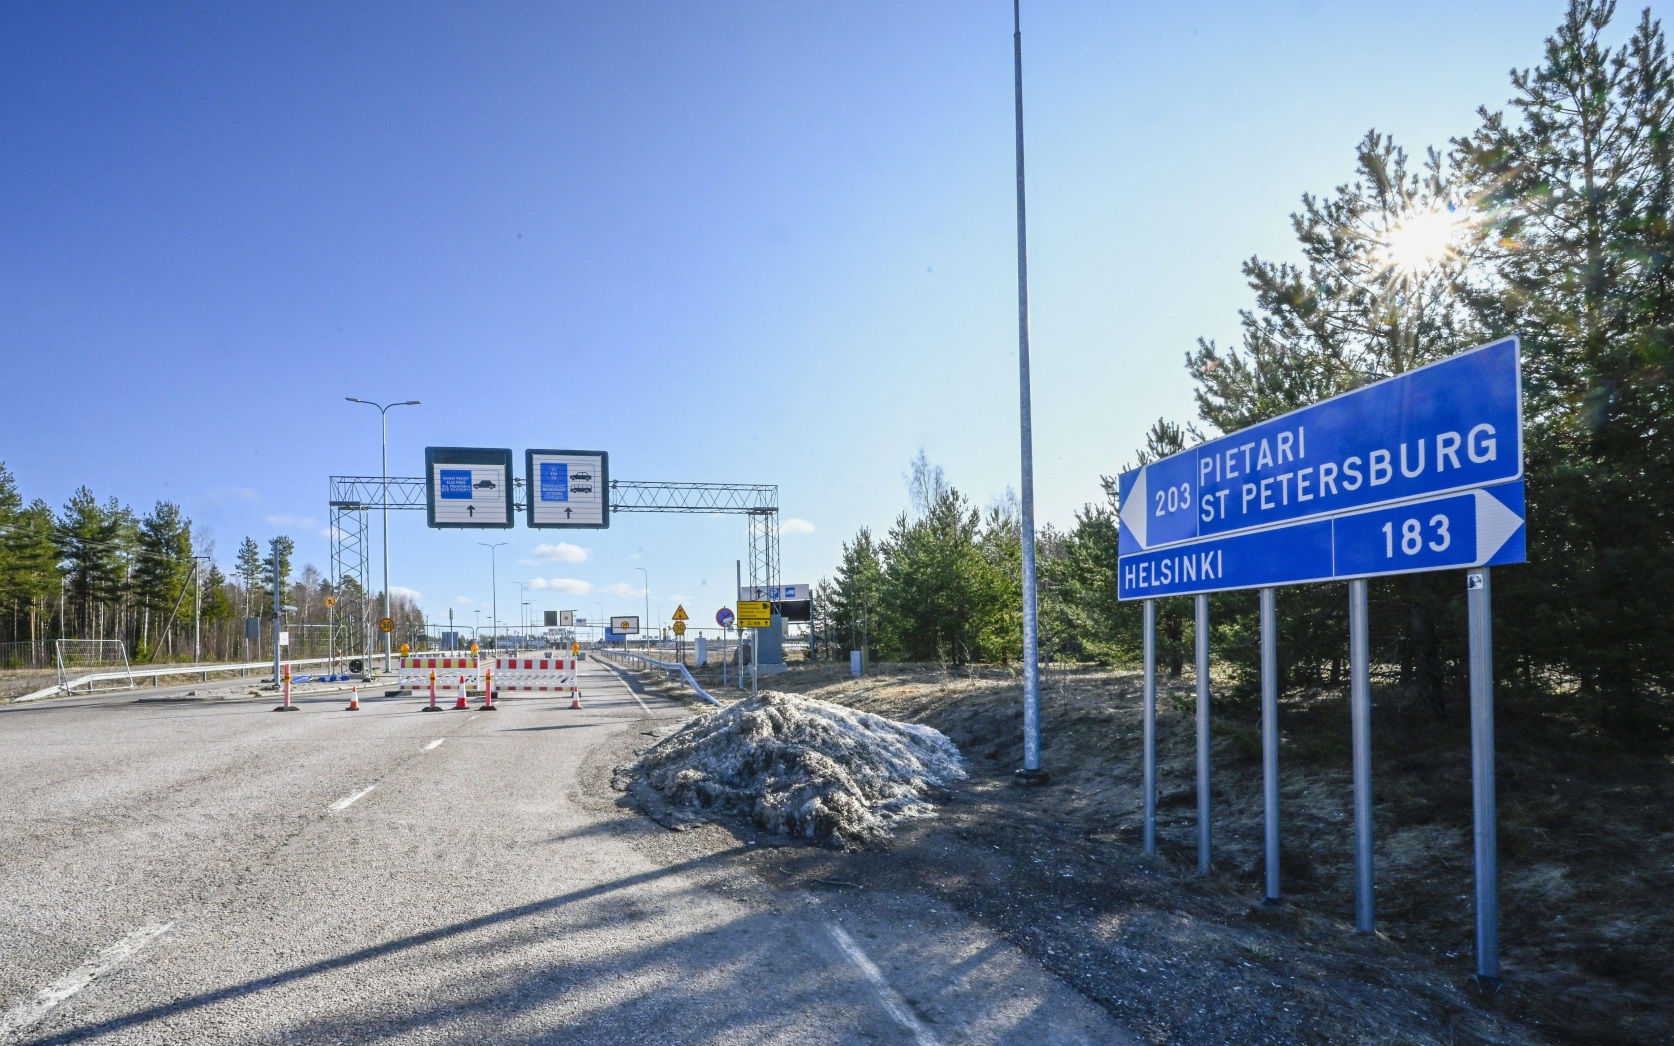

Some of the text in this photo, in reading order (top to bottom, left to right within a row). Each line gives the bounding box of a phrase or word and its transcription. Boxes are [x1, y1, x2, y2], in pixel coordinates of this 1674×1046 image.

[1200, 426, 1305, 488] PIETARI
[1201, 423, 1498, 523] ST PETERSBURG
[1155, 482, 1191, 517] 203
[1382, 514, 1451, 559] 183
[1125, 549, 1222, 590] HELSINKI
